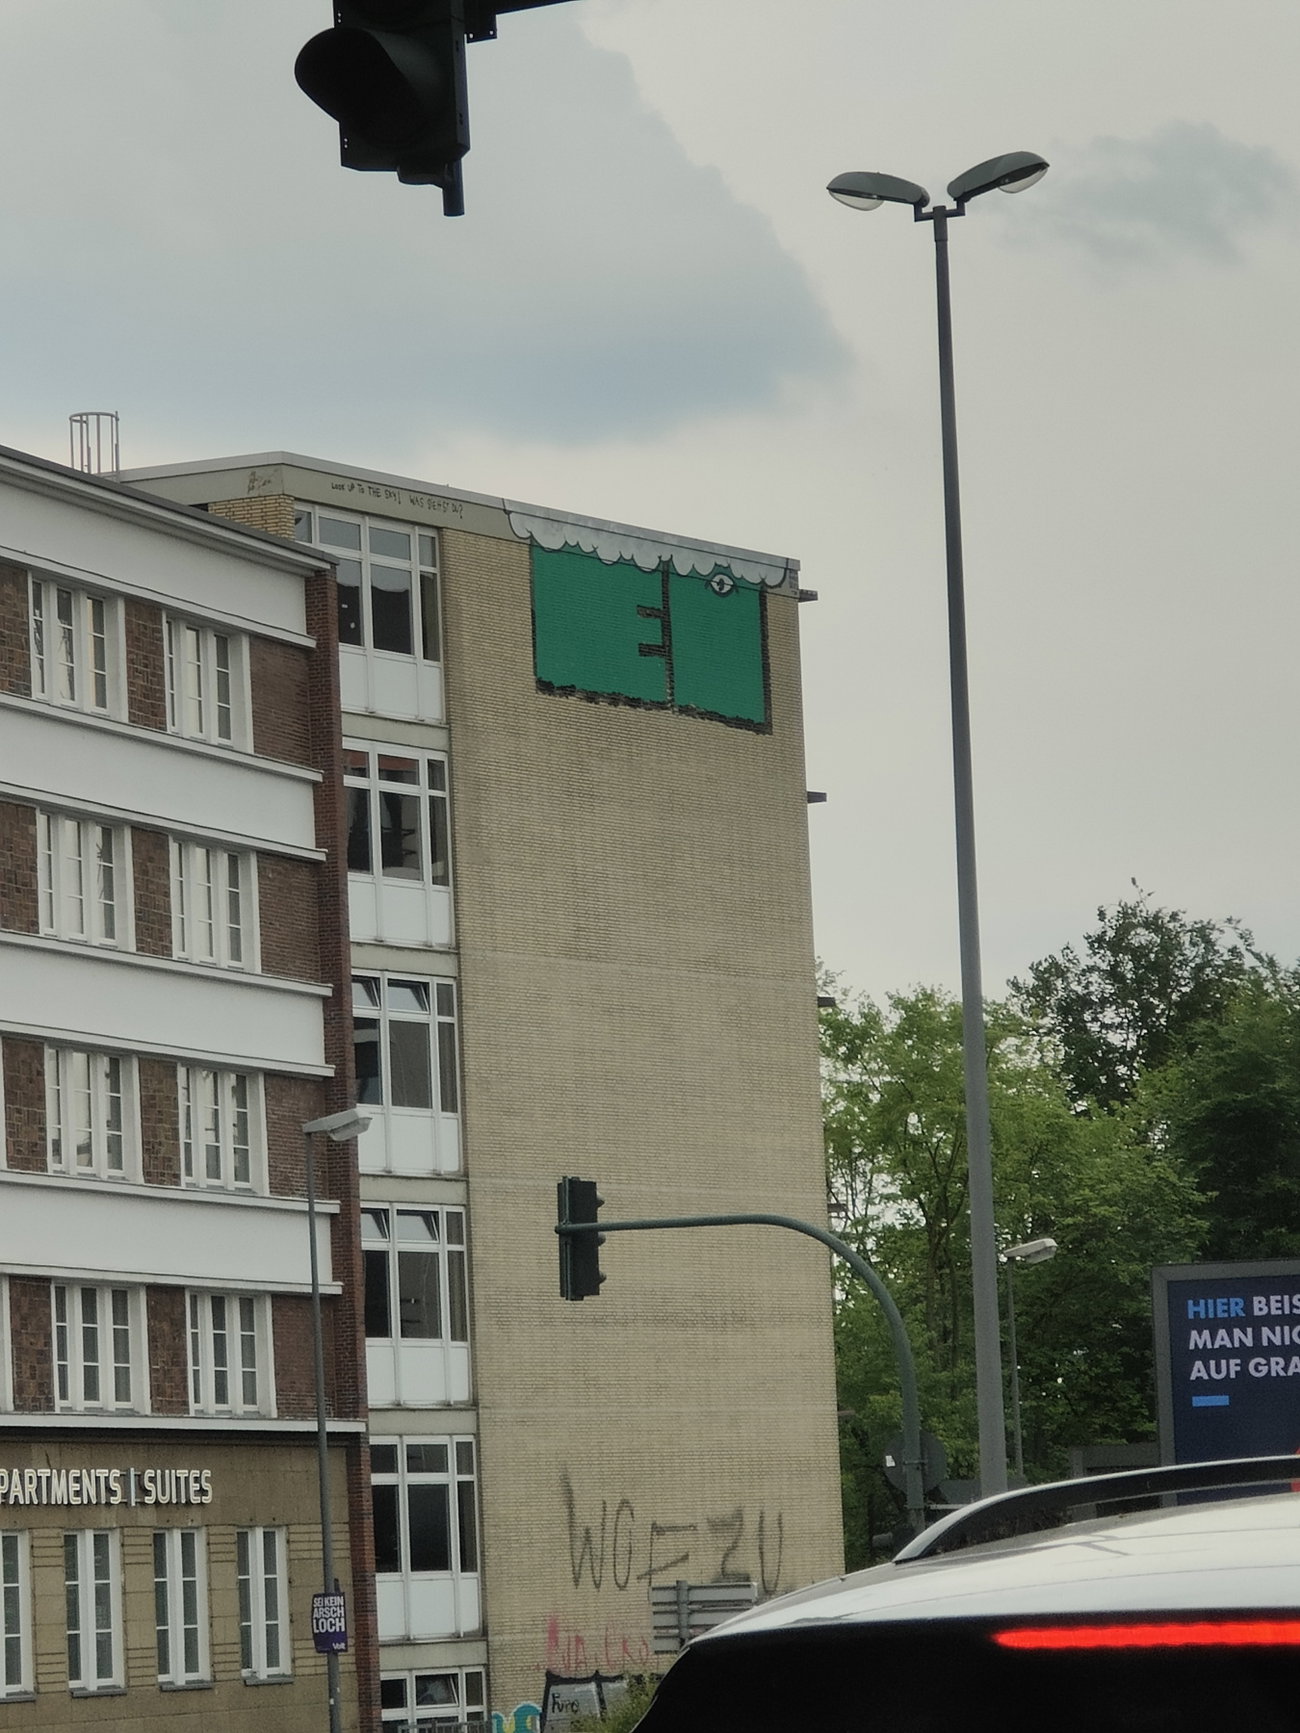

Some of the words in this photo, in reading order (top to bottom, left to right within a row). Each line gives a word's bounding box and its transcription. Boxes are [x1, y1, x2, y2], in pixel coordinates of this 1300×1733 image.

[367, 486, 382, 498] THE
[409, 495, 424, 508] WAS
[1187, 1297, 1245, 1320] HIER
[1252, 1293, 1300, 1316] BEIS
[1189, 1327, 1253, 1350] MAN
[1189, 1358, 1241, 1381] AUF
[1248, 1356, 1300, 1378] GRA
[144, 1469, 212, 1504] SUITES
[313, 1596, 323, 1607] SEI
[324, 1595, 344, 1607] KEIN
[313, 1606, 344, 1619] ARSCH
[313, 1618, 345, 1633] LOCH
